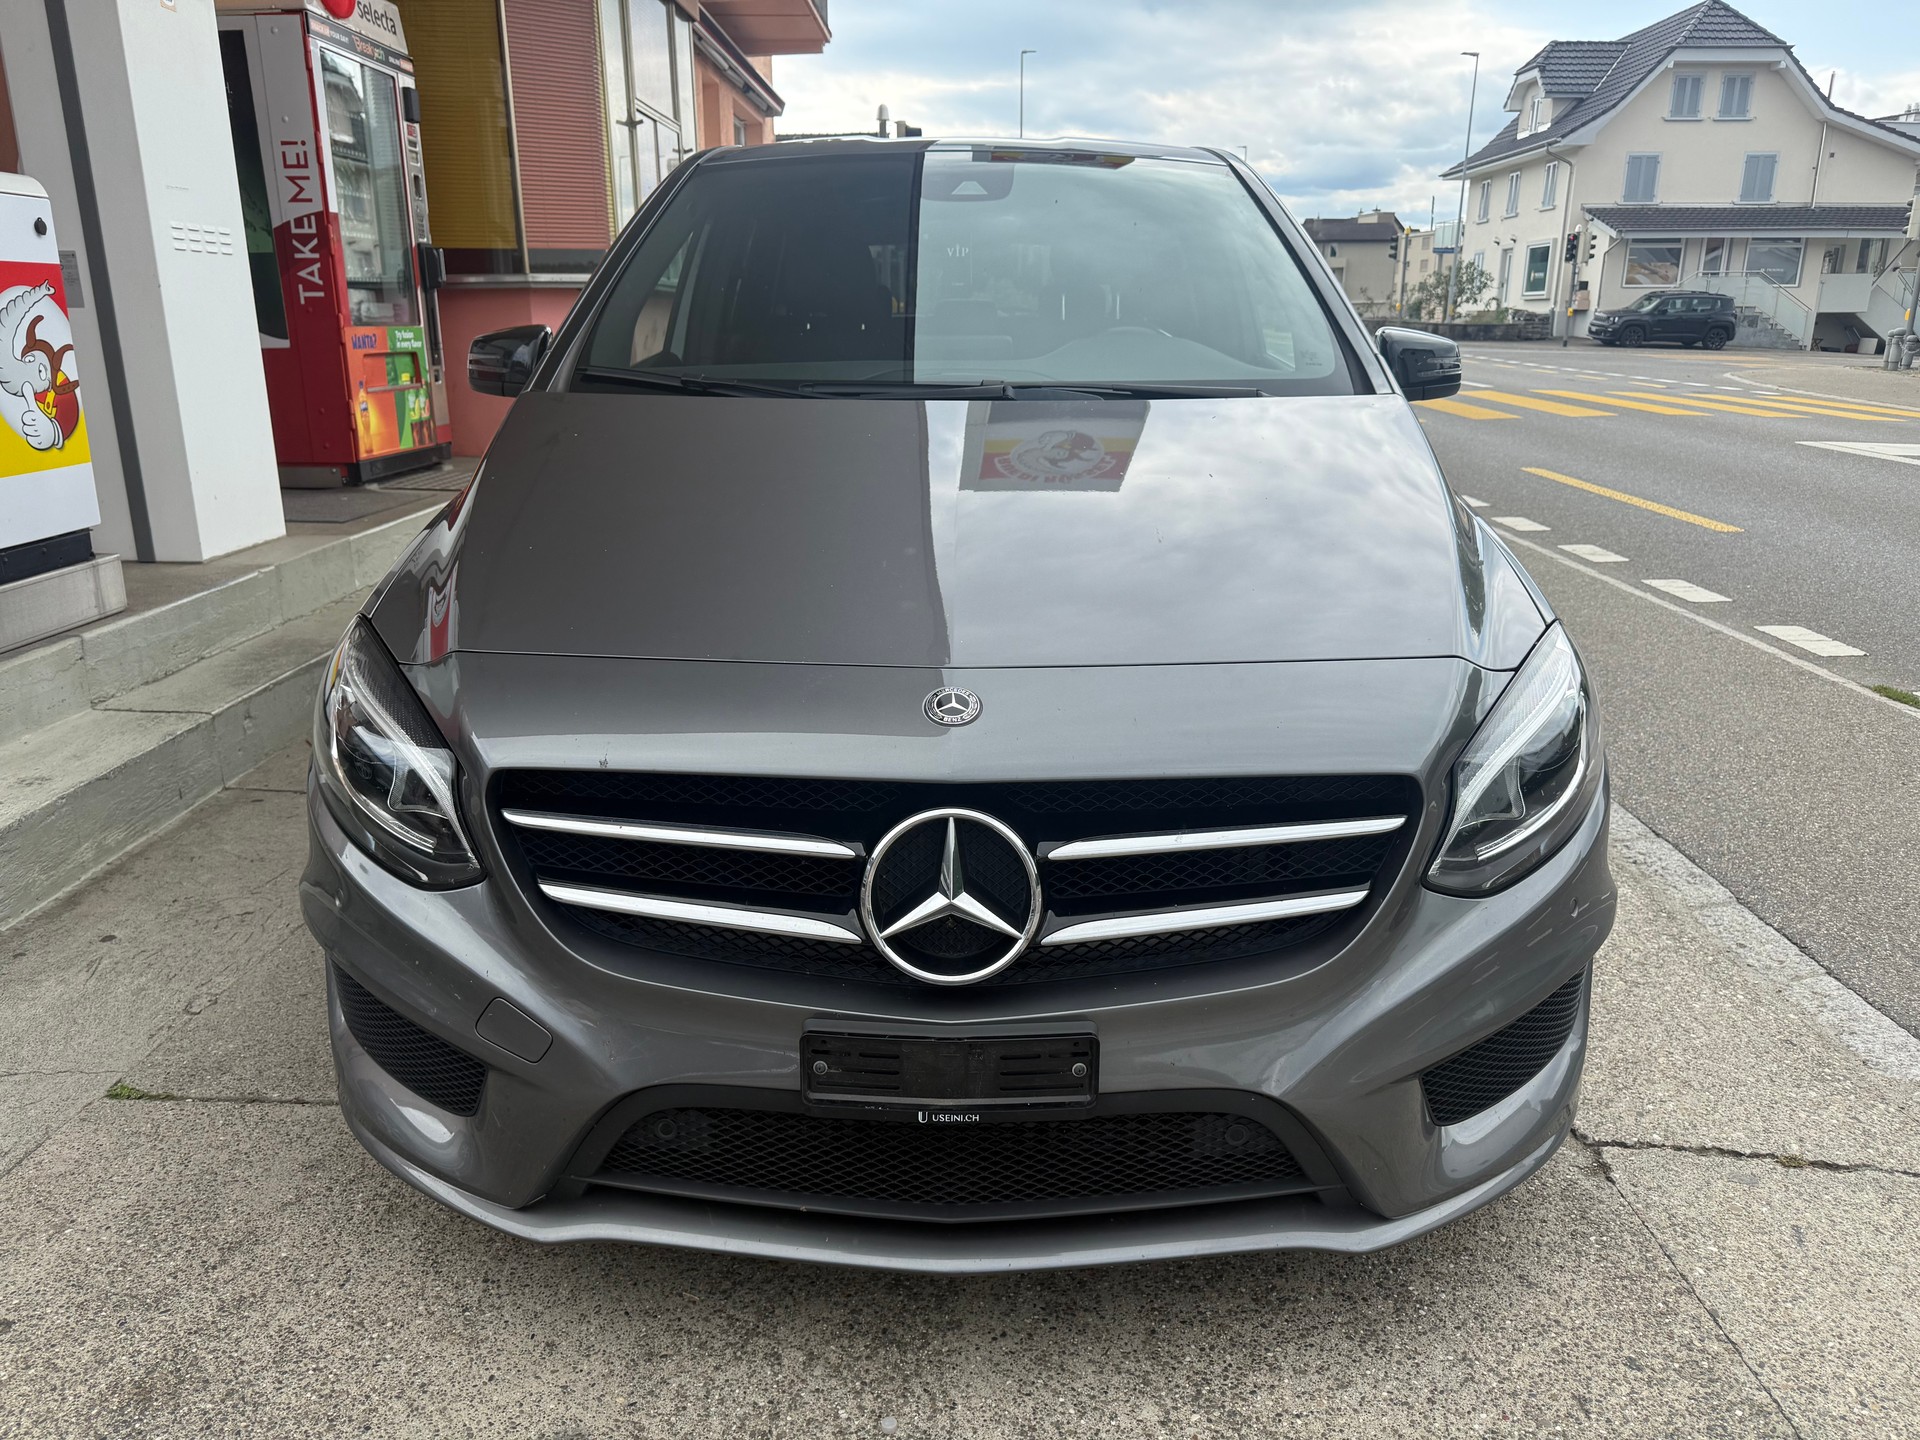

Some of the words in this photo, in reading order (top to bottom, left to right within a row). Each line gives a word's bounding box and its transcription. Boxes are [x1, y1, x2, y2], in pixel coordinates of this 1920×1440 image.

[356, 0, 397, 36] selecta
[280, 140, 314, 203] ME!
[289, 215, 325, 305] TAKE
[932, 1114, 980, 1122] USEINI.CH
